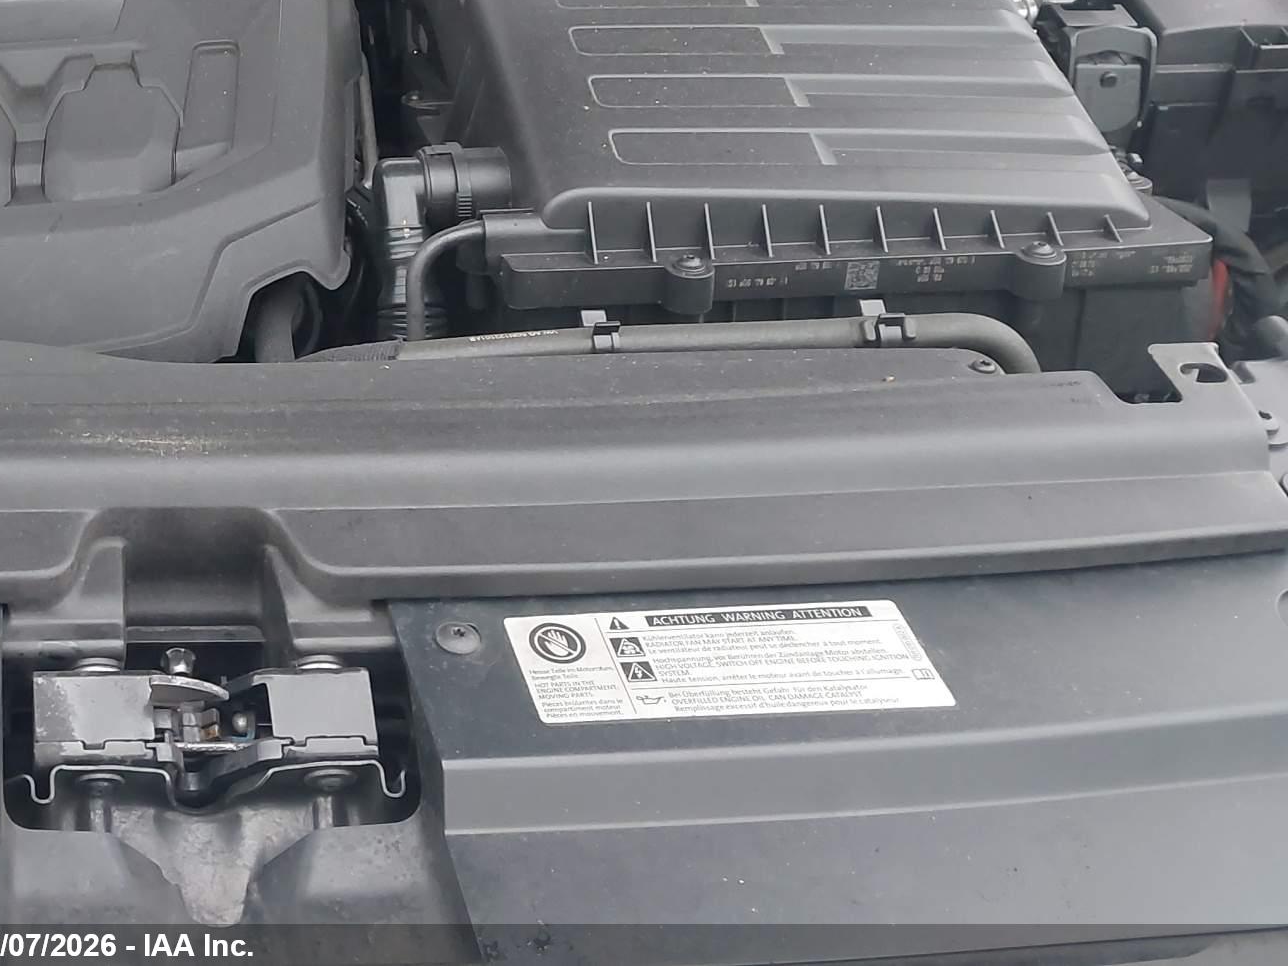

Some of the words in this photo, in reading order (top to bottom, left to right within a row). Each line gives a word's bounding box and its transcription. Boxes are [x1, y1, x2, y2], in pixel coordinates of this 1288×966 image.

[652, 614, 714, 625] ACHTUNG
[723, 611, 784, 622] WARNING
[792, 607, 861, 619] ATTENTION
